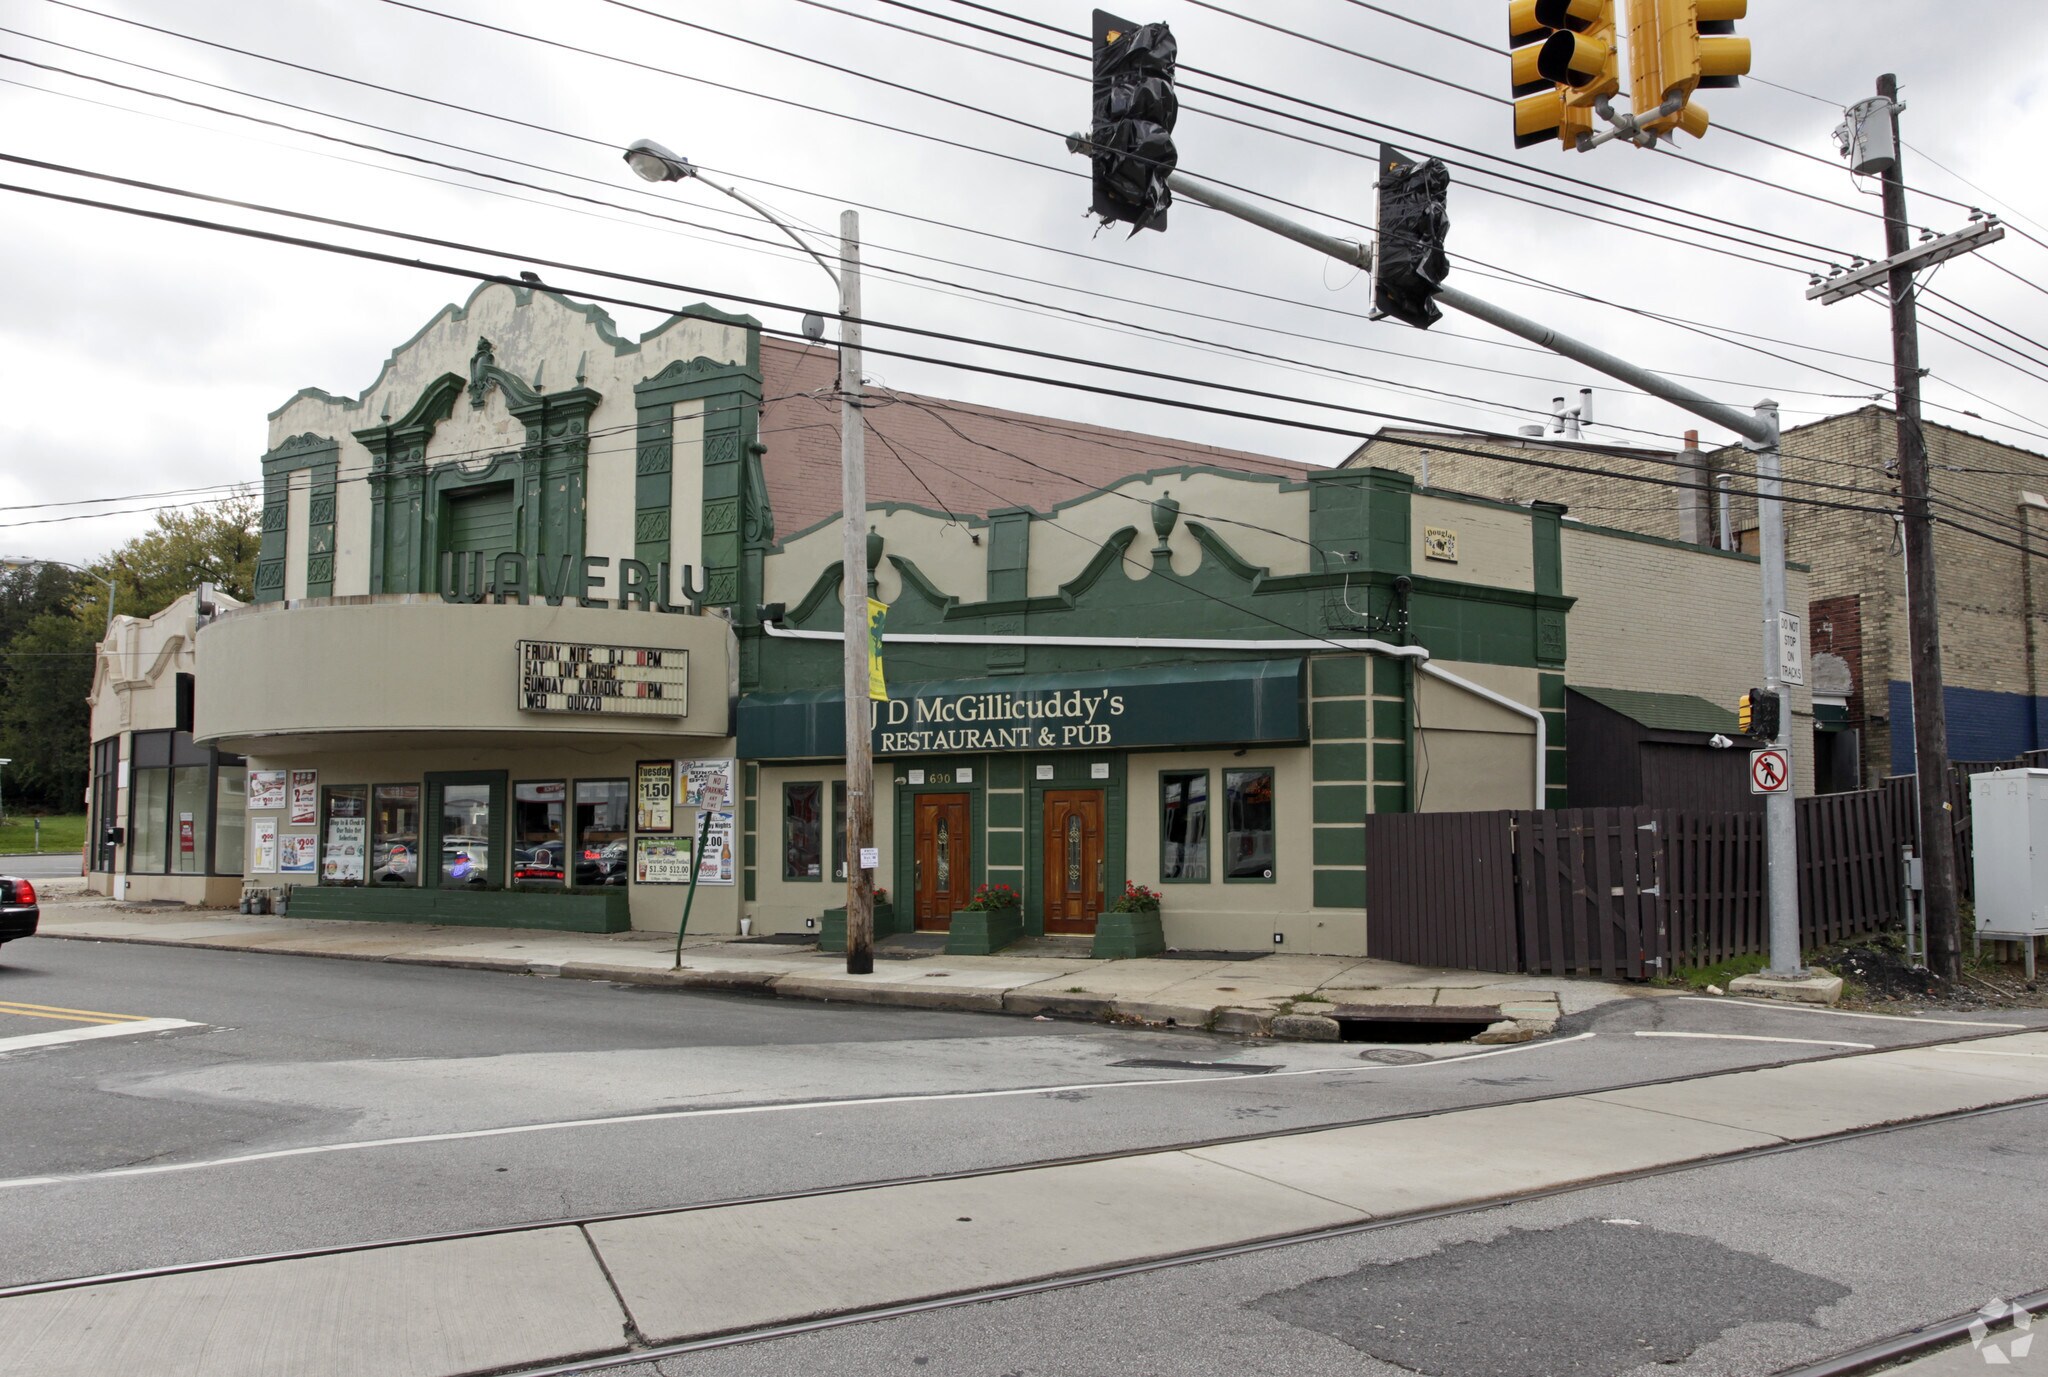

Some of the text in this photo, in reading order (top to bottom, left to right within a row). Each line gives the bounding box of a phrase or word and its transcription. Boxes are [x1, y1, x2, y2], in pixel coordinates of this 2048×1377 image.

[1428, 529, 1455, 541] Douglas
[440, 551, 711, 616] WAVERLY
[1781, 618, 1798, 632] DO NOT
[1784, 635, 1796, 646] STOP
[525, 644, 562, 660] FRIDAY
[570, 646, 592, 663] NITE
[1787, 651, 1794, 662] ON
[525, 661, 616, 680] SAT LIVE MUSIC
[1782, 665, 1801, 679] TRACKS
[524, 677, 564, 694] SUNDAY
[579, 680, 624, 696] KARAOKE
[526, 693, 547, 709] WED
[887, 700, 908, 724] D
[916, 689, 1124, 724] McGillicuddy's
[881, 724, 1112, 752] RESTAURANT & PUB
[640, 767, 672, 777] Tuesday
[930, 774, 950, 784] 690
[640, 783, 669, 797] $1.50
[706, 786, 725, 795] PARKING
